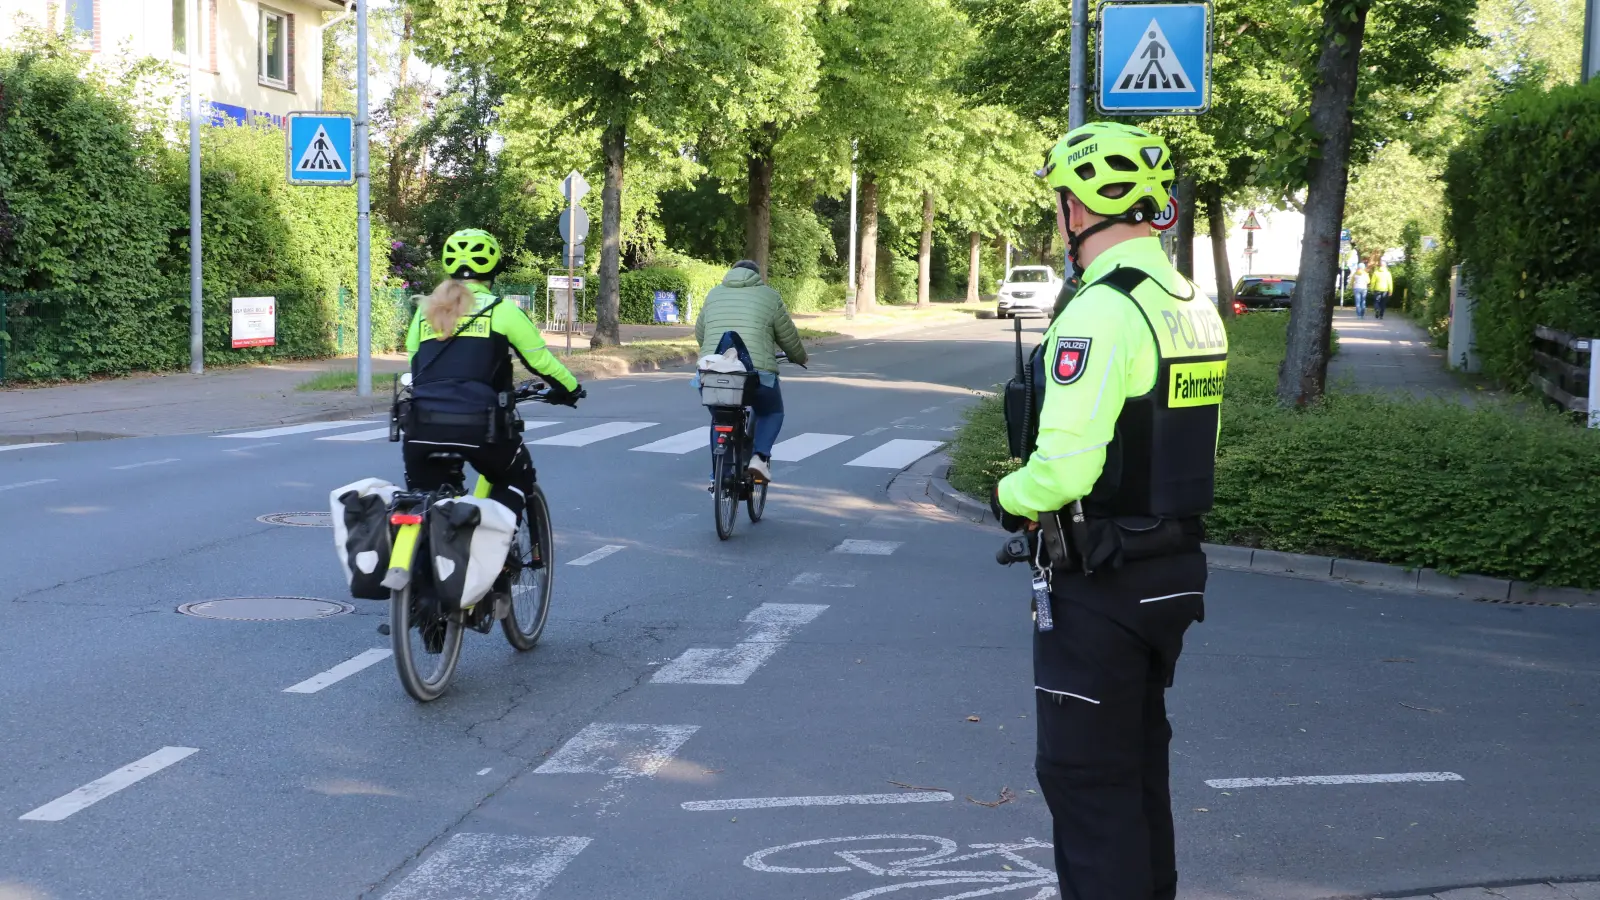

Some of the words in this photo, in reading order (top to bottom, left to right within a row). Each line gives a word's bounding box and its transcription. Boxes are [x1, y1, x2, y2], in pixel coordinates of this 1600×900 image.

[1067, 143, 1098, 165] POLIZEI
[1161, 309, 1226, 350] POLIZEI
[1059, 341, 1086, 349] POLIZEI
